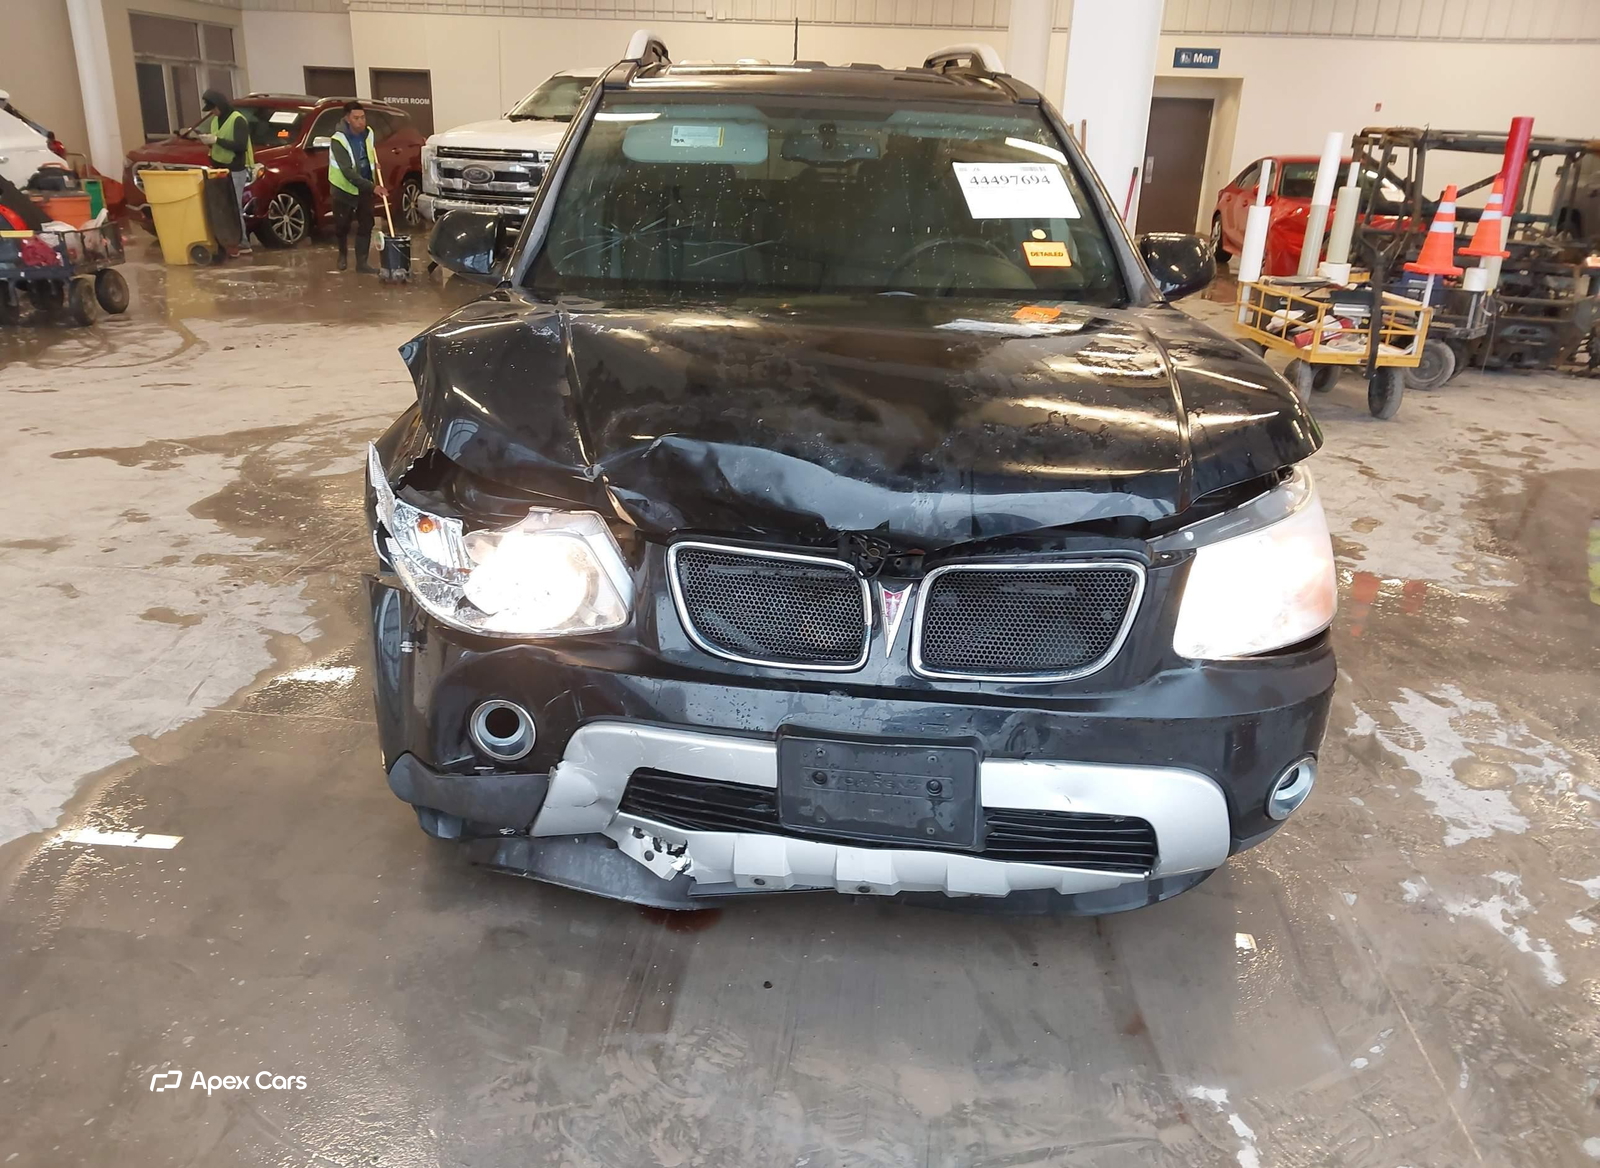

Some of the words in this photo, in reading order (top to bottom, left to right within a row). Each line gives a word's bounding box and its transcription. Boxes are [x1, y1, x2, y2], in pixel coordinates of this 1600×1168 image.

[1193, 52, 1214, 64] Men
[383, 96, 409, 104] SERVER
[970, 174, 1051, 186] 44497694
